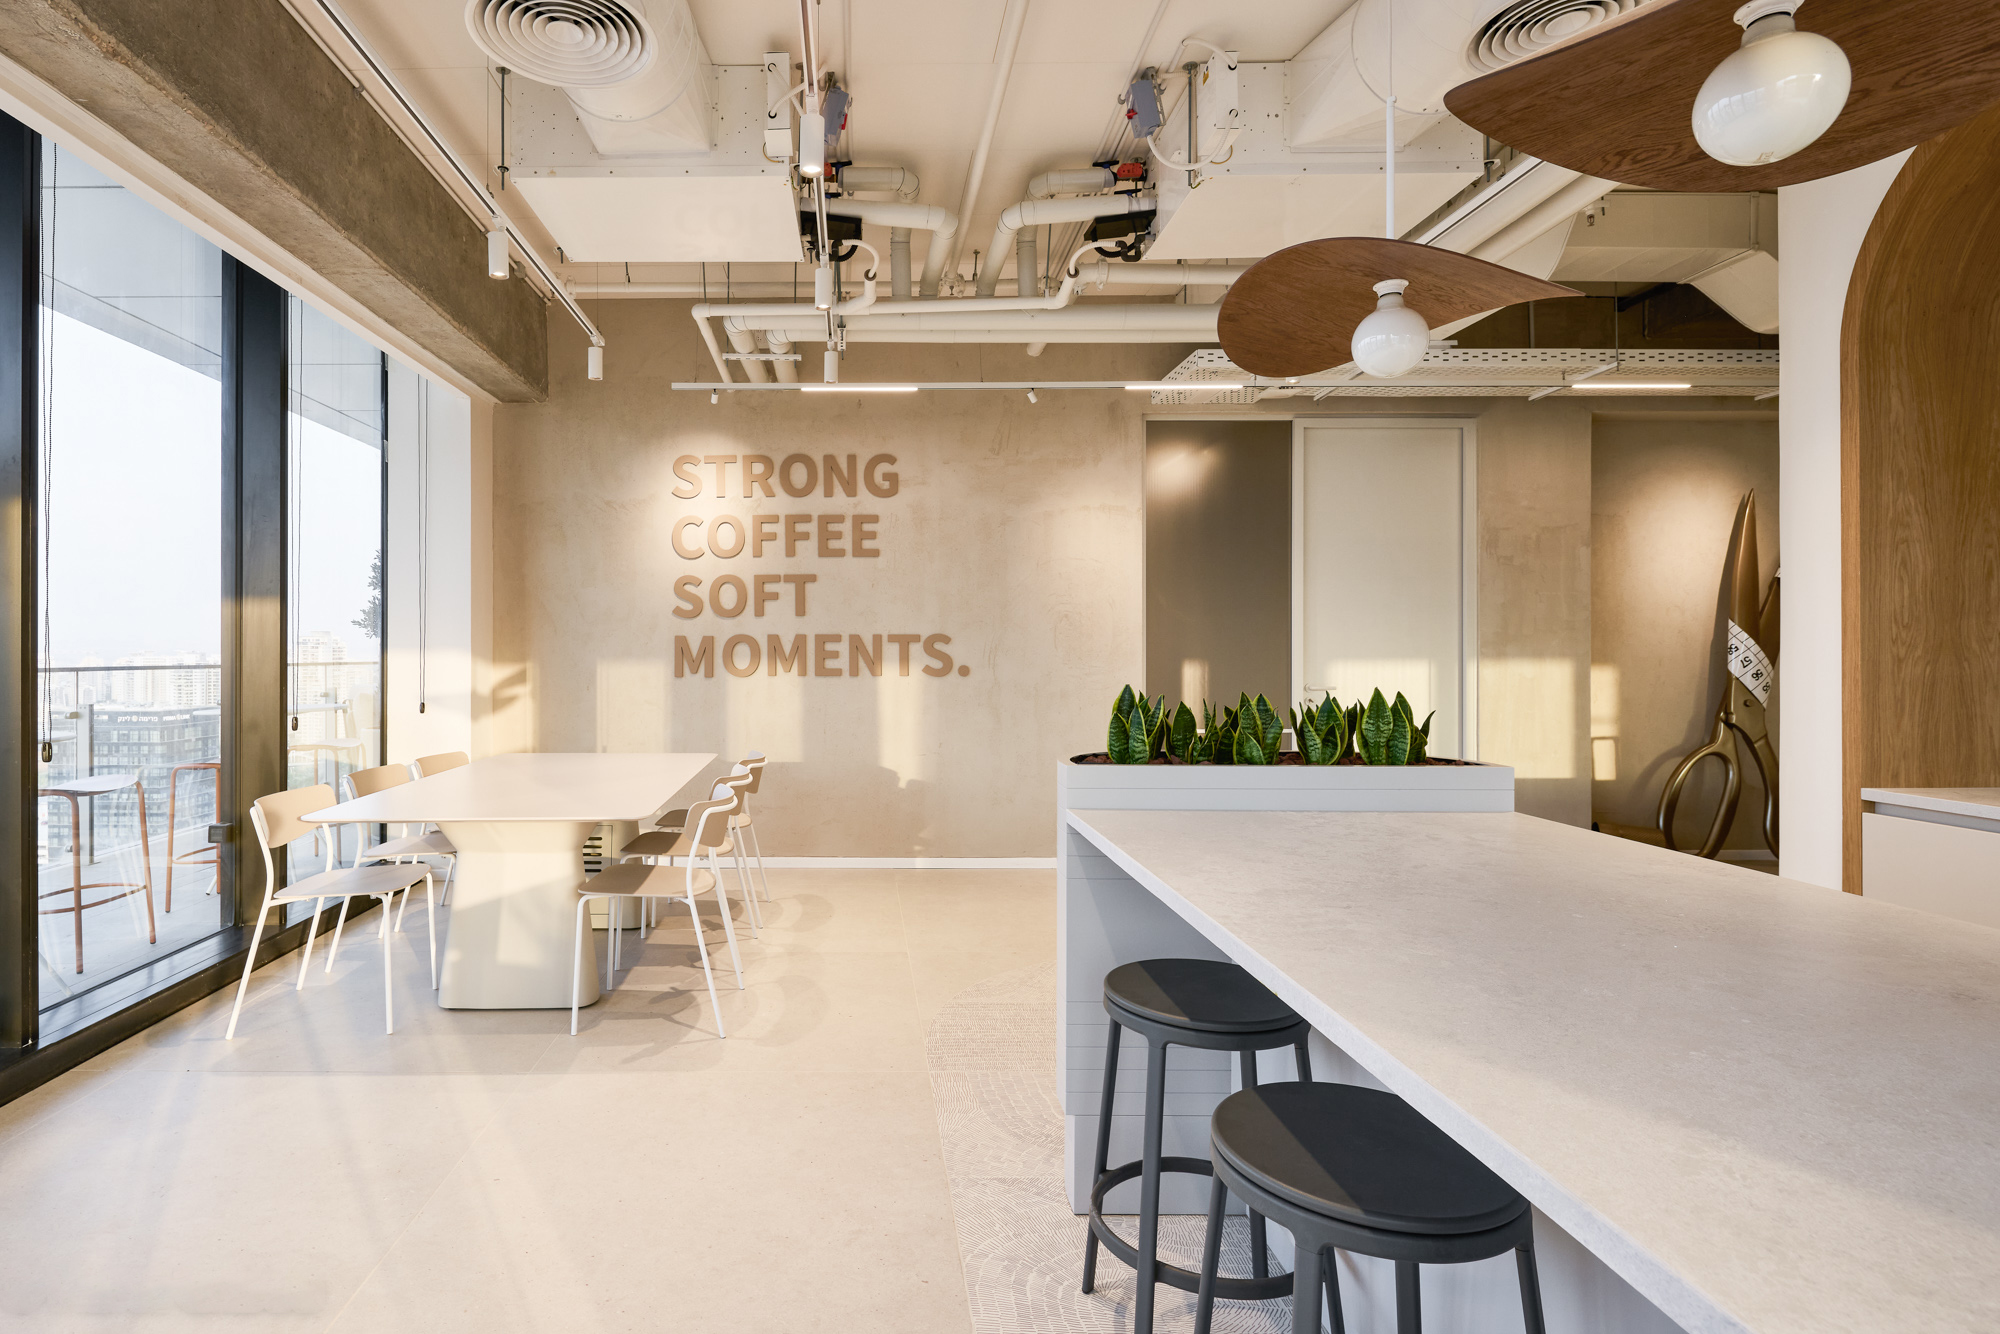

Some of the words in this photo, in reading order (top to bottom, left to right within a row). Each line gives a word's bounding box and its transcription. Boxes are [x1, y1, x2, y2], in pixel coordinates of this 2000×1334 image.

[671, 453, 899, 499] STRONG
[671, 514, 880, 560] COFFEE
[671, 574, 817, 619] SOFT
[673, 633, 970, 678] MOMENTS.
[1740, 656, 1753, 669] 57
[1751, 668, 1764, 681] 56
[1762, 681, 1771, 694] 55
